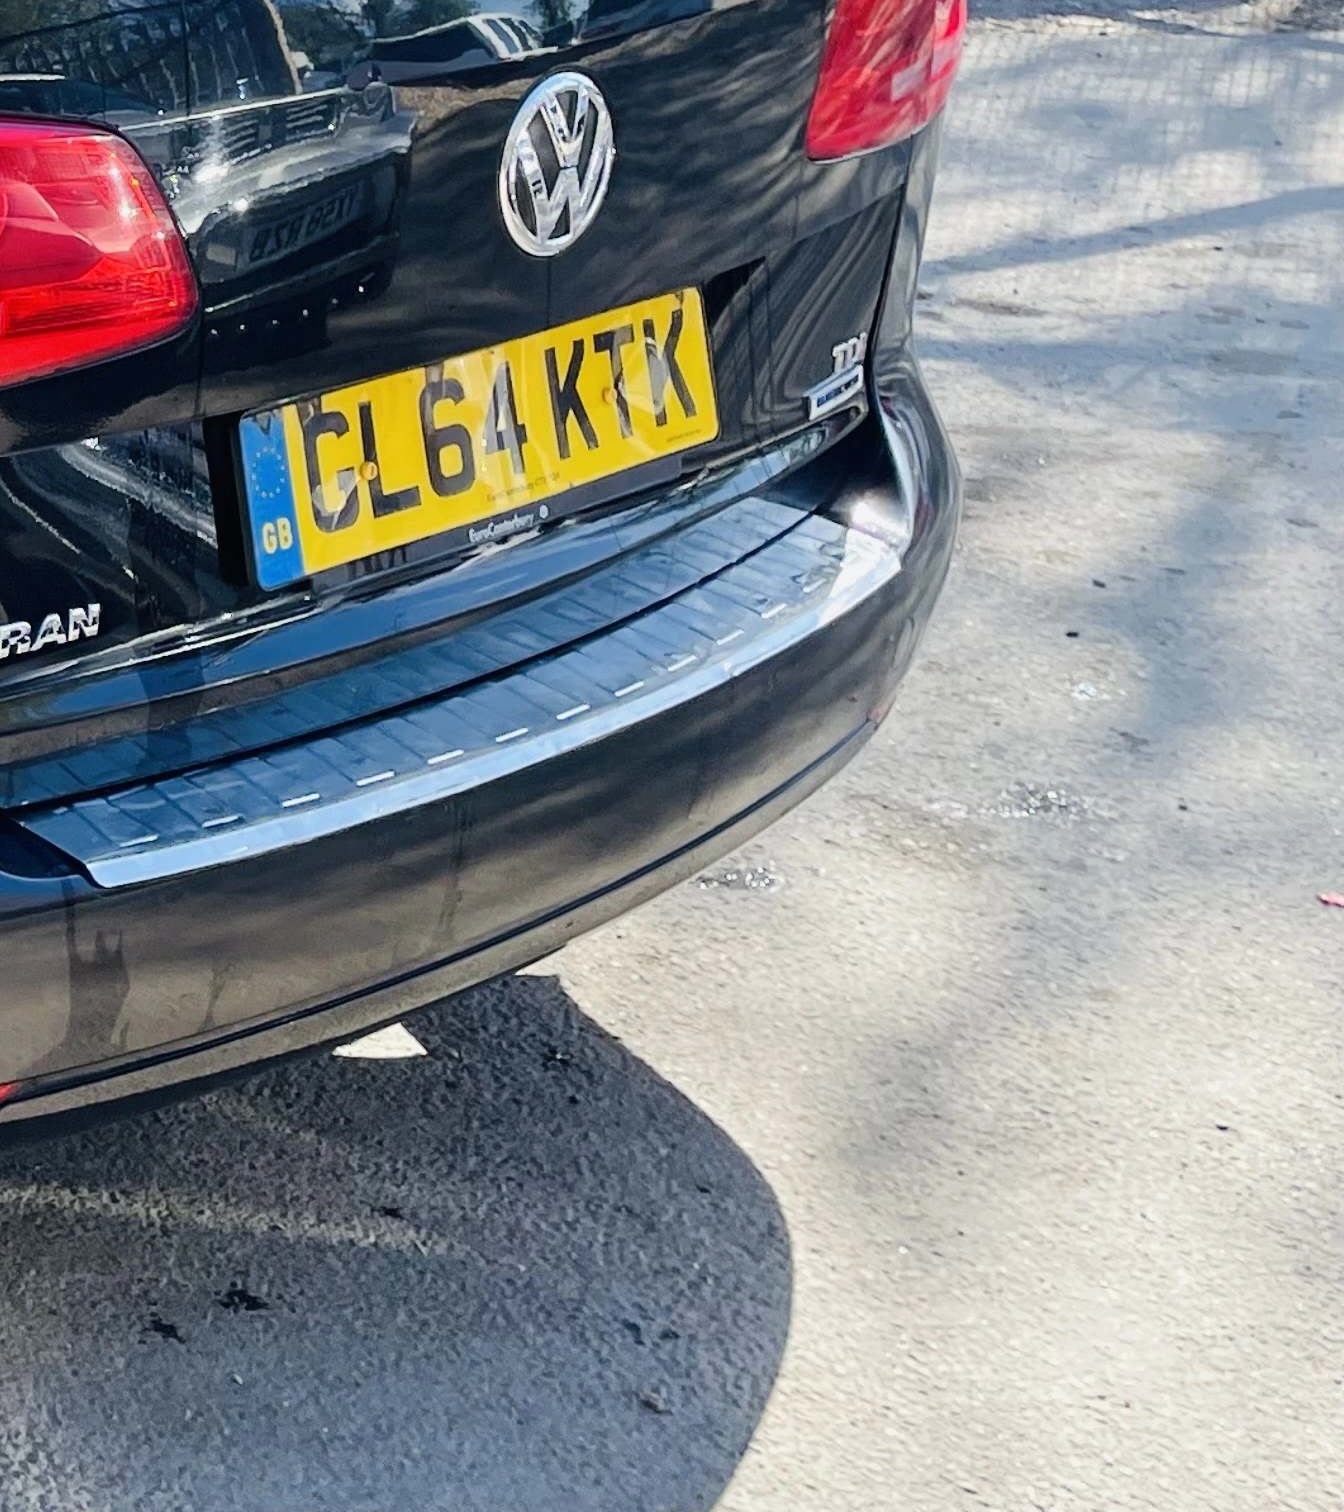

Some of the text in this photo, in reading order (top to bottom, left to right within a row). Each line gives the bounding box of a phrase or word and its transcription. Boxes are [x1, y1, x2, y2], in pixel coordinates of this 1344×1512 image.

[302, 308, 697, 534] GL64 KTK
[262, 520, 294, 555] GB
